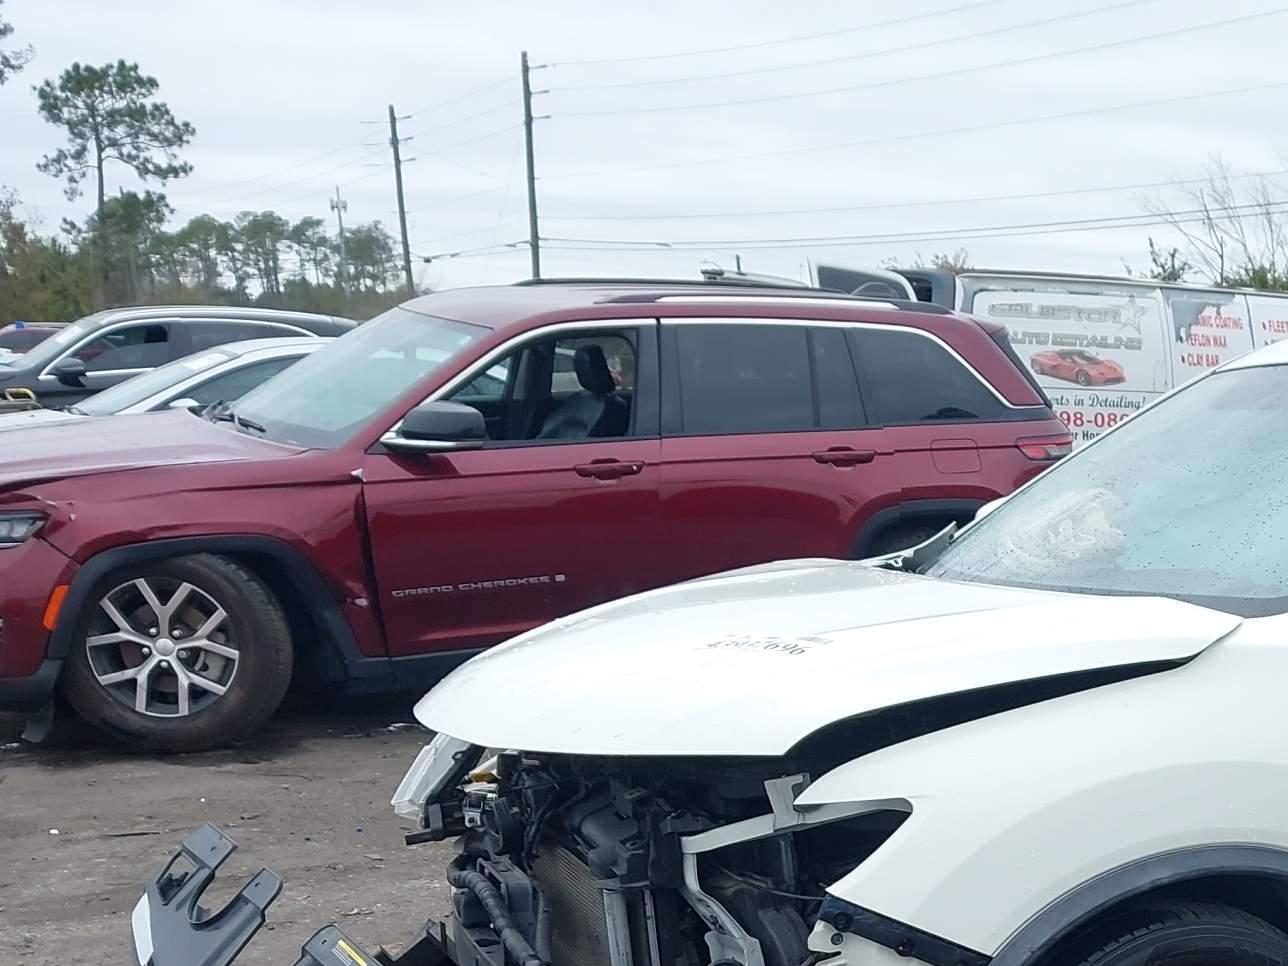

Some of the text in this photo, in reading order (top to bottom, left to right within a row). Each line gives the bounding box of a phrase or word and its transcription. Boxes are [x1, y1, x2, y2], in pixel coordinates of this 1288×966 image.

[1213, 335, 1227, 348] WAX
[1187, 353, 1219, 368] CLAY BAR
[1074, 394, 1084, 406] in
[1088, 394, 1146, 410] Detailing!
[391, 585, 453, 597] GRAND
[458, 575, 550, 591] CHEROKEE
